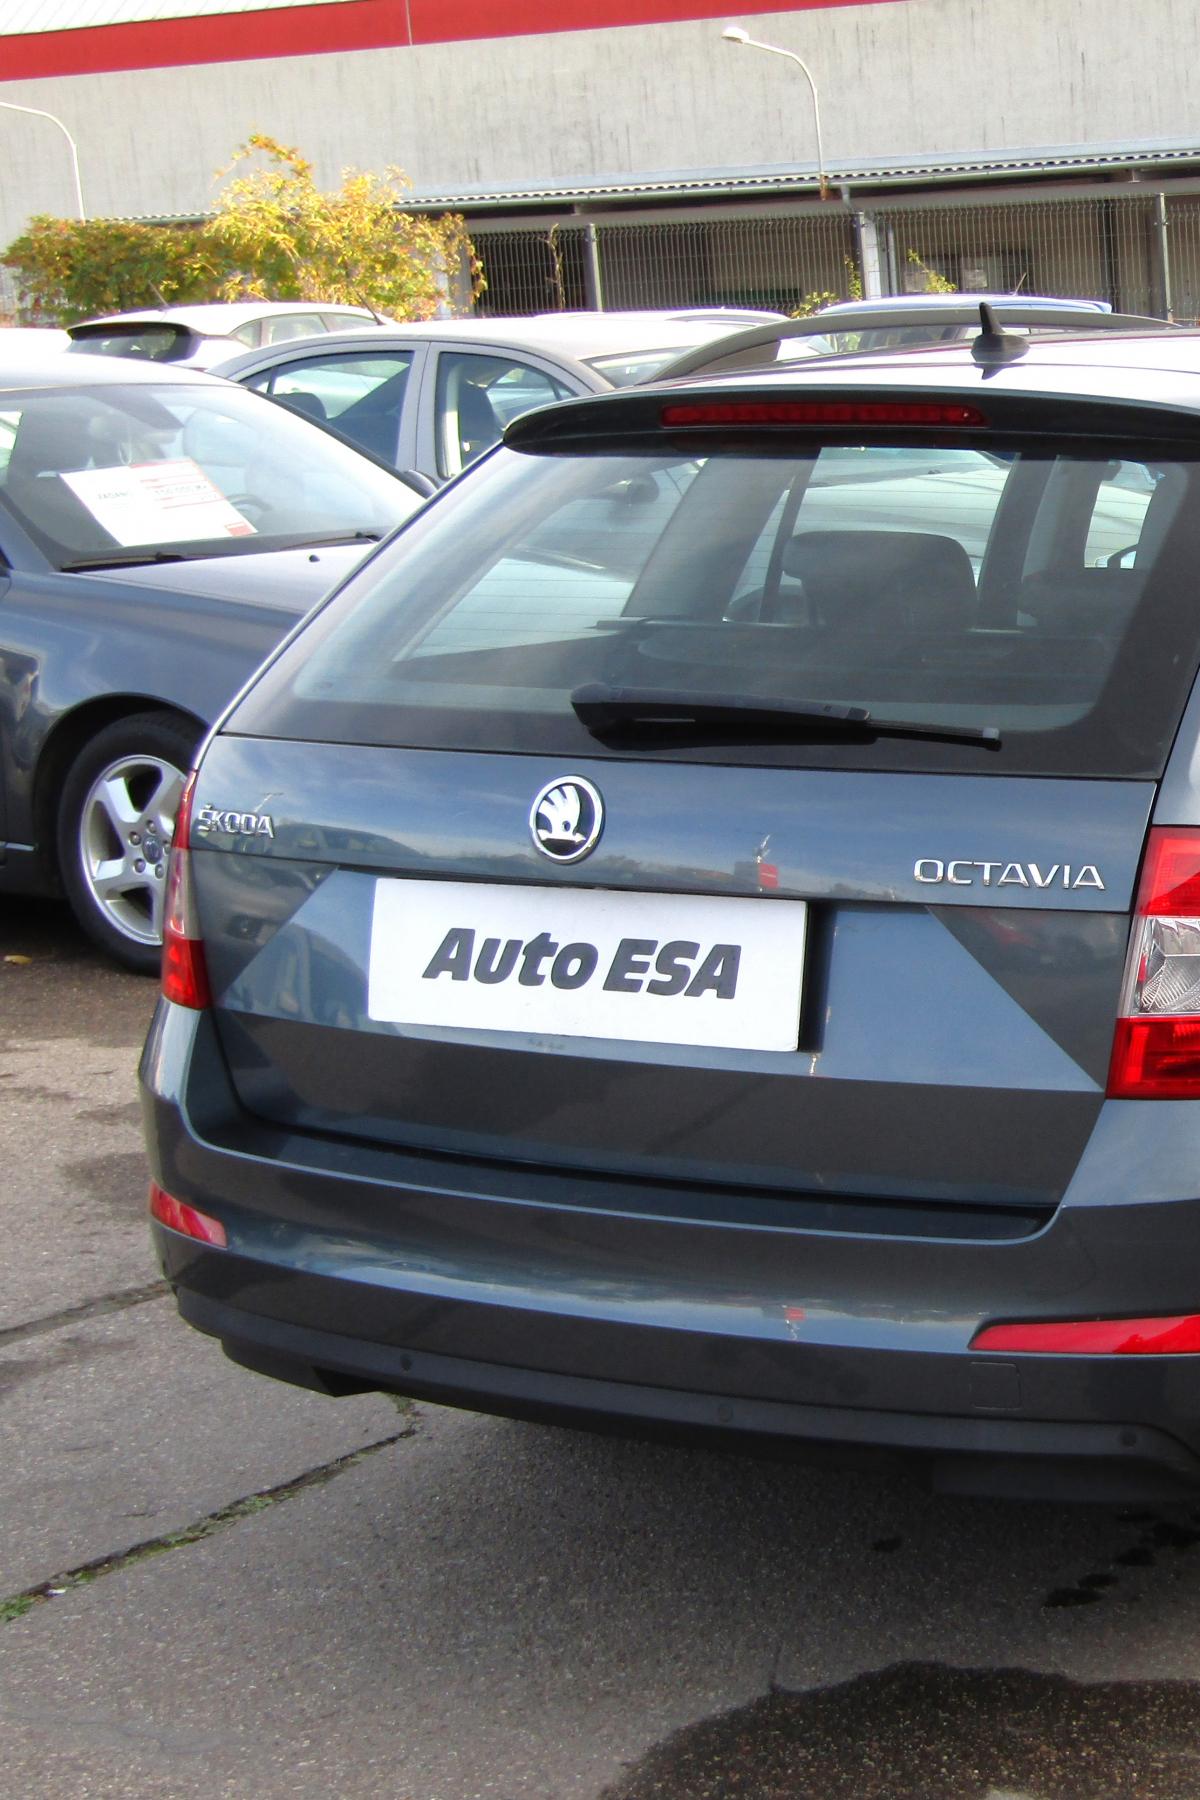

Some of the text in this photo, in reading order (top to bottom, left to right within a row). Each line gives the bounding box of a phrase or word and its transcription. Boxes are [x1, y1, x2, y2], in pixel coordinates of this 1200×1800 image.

[198, 803, 275, 838] ŠKODA
[913, 858, 1105, 890] OCTAVIA
[422, 927, 742, 1000] Auto ESA
